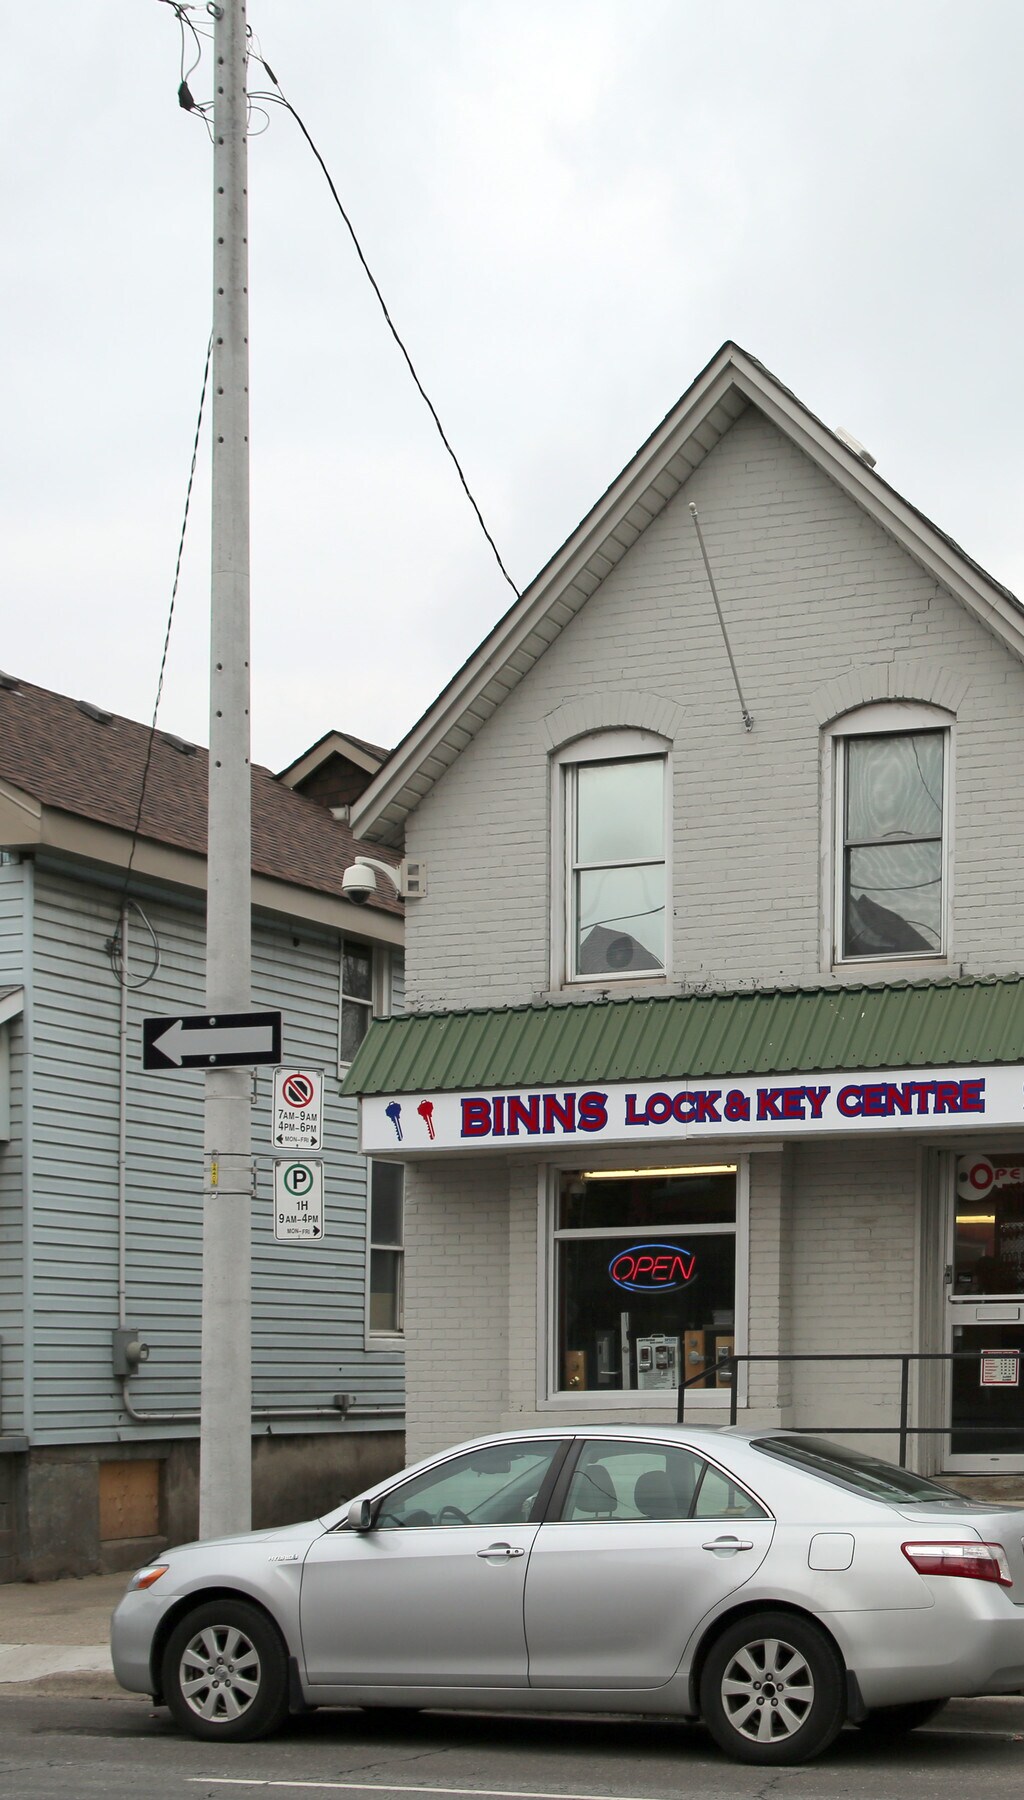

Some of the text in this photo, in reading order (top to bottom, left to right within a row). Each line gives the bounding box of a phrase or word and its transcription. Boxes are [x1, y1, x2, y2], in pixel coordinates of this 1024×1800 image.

[460, 1091, 609, 1138] BINNS
[836, 1078, 985, 1117] CENTRE
[293, 1170, 307, 1189] P
[296, 1201, 308, 1211] 1H
[612, 1256, 696, 1280] OPEN
